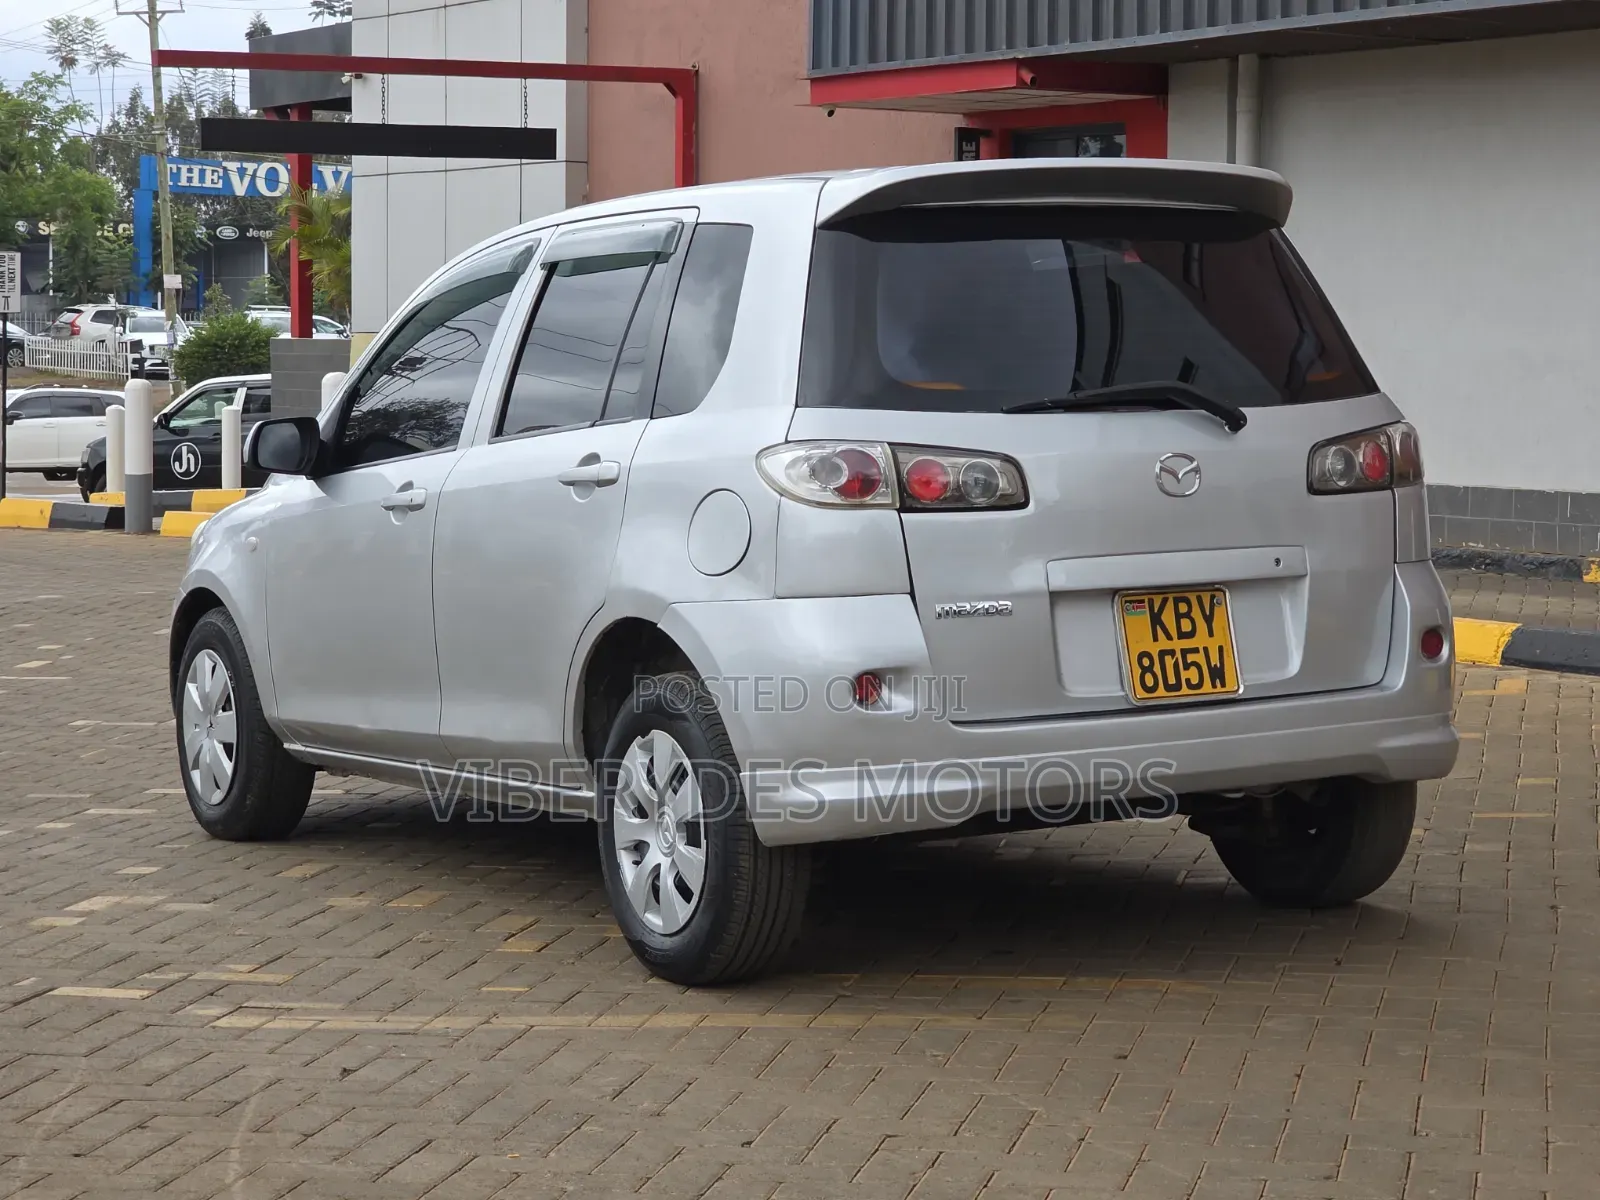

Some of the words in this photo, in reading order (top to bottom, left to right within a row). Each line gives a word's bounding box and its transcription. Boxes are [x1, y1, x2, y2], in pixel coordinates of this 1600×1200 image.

[167, 163, 223, 189] THE
[222, 161, 352, 199] VOV
[246, 228, 273, 239] Jeep
[7, 267, 16, 284] NEXT
[1147, 594, 1217, 643] KBY
[1136, 645, 1227, 694] 805W
